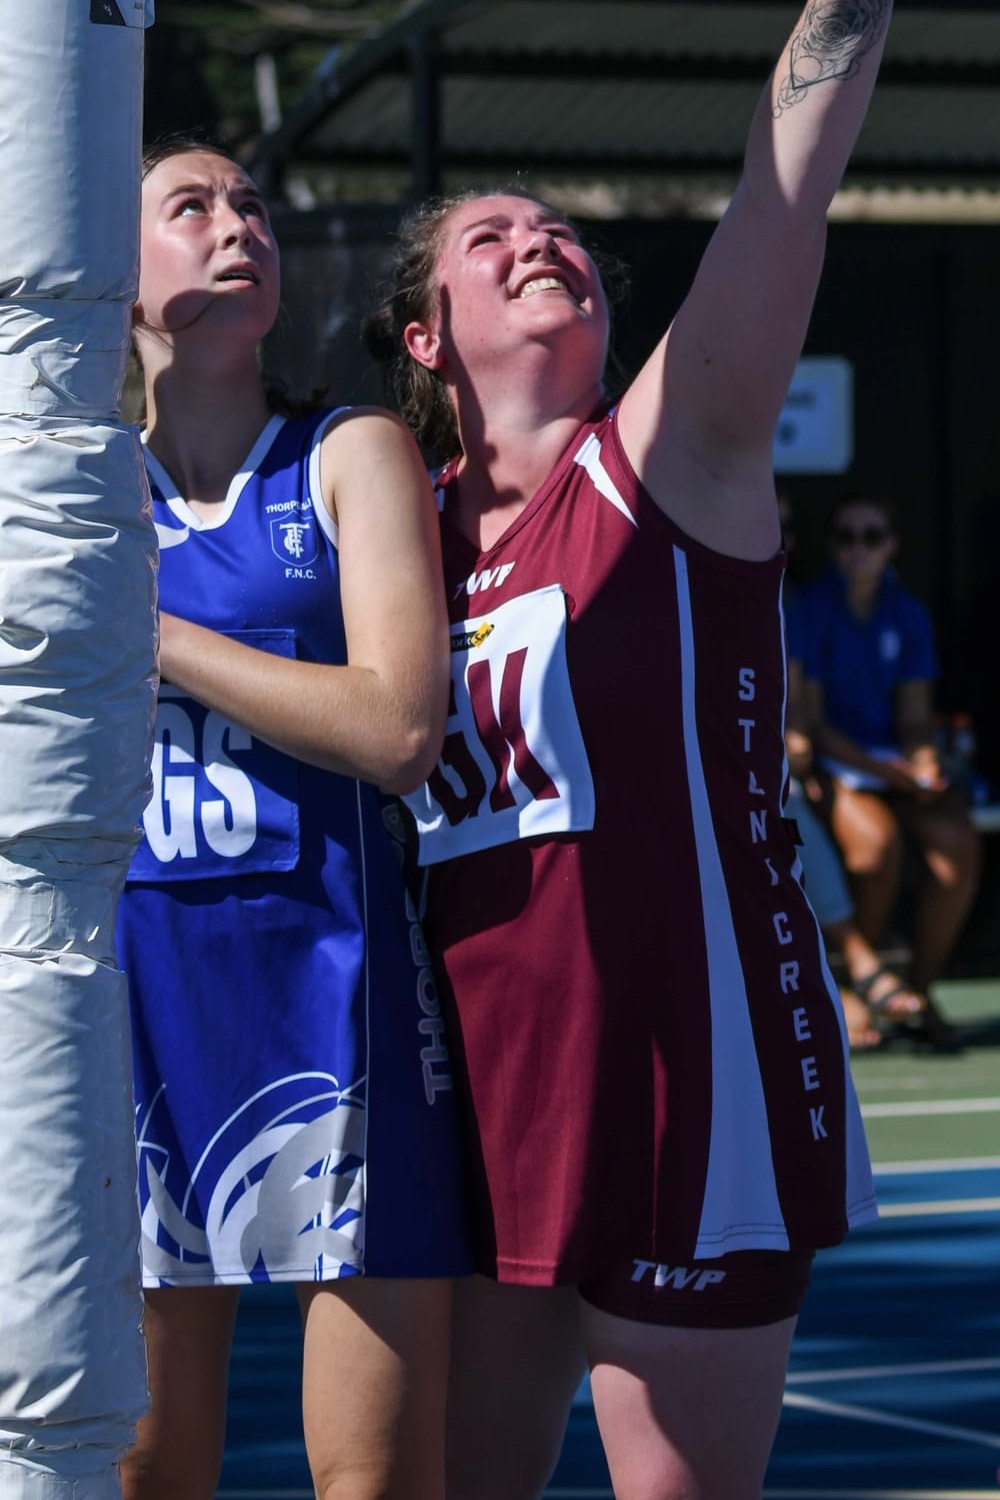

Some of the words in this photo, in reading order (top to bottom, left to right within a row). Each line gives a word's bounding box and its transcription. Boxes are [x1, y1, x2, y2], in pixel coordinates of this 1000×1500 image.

[285, 568, 316, 580] F.N.C.
[143, 703, 257, 863] GS
[773, 912, 828, 1141] CREEK
[630, 1259, 727, 1291] TWP
